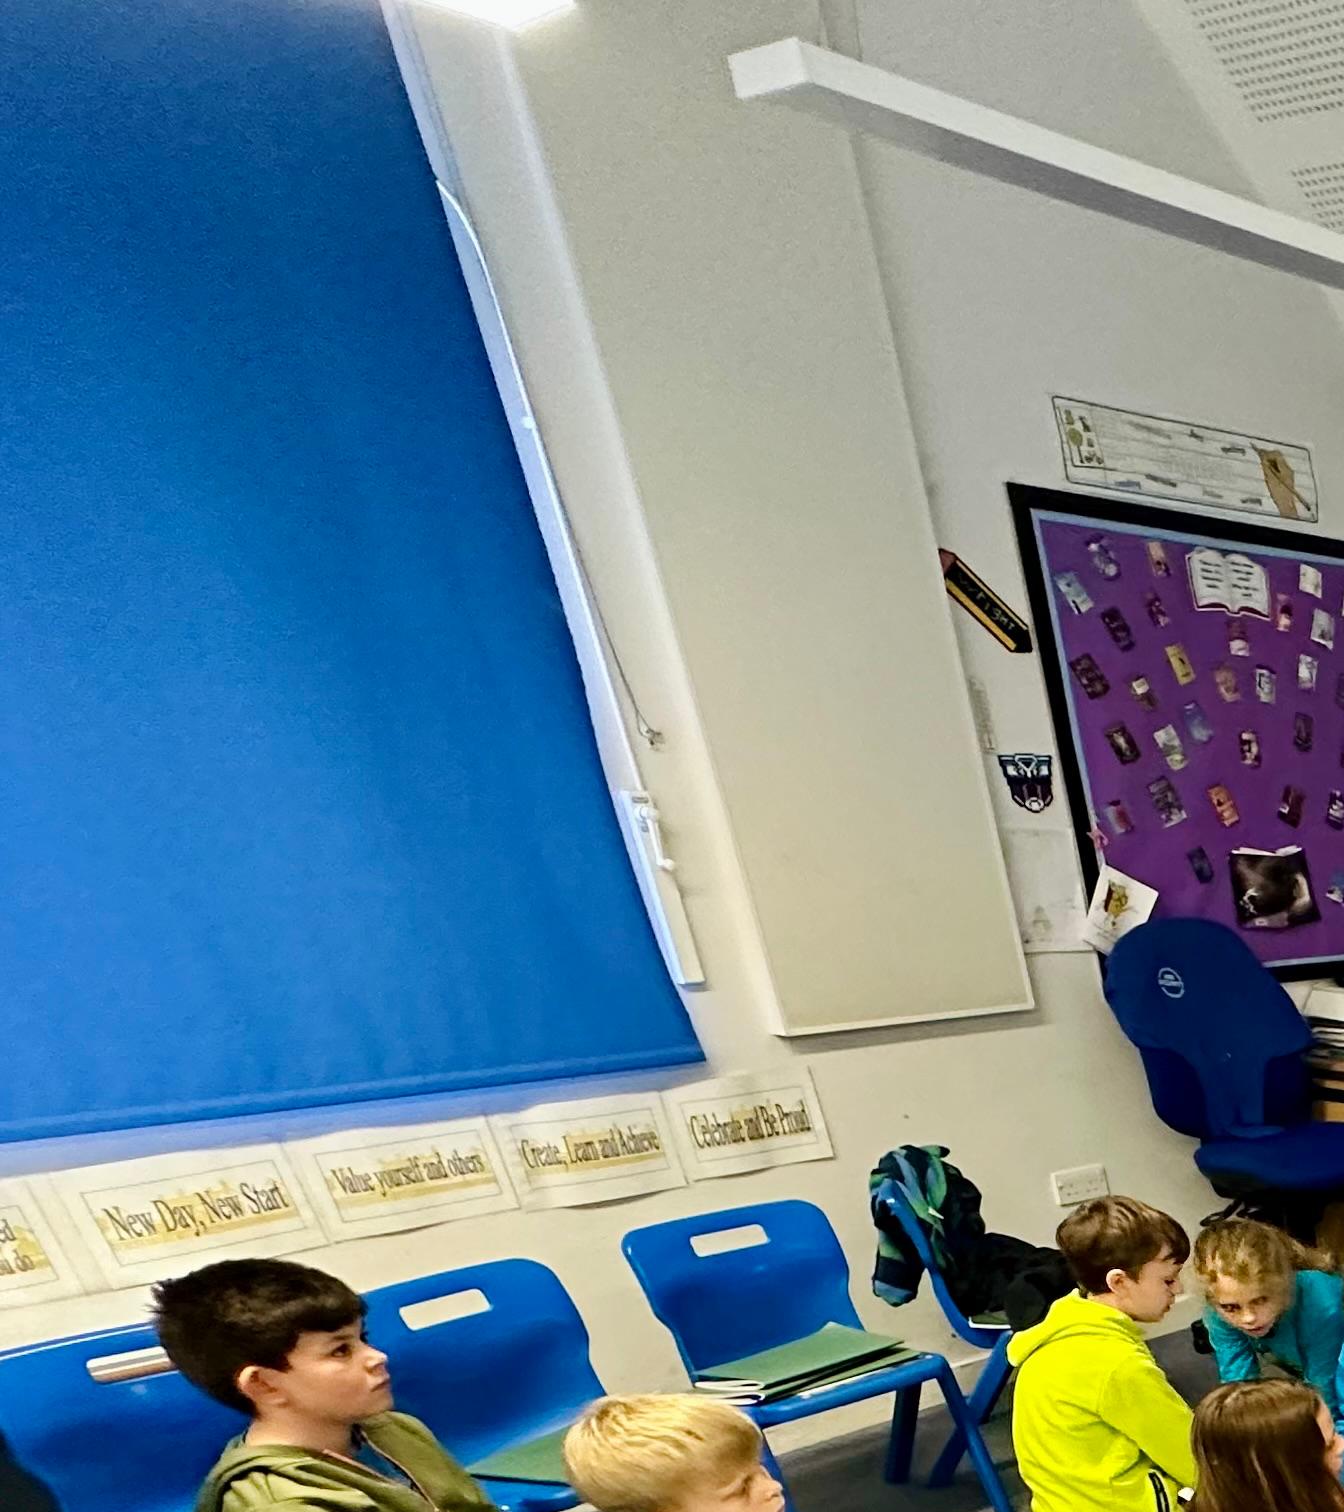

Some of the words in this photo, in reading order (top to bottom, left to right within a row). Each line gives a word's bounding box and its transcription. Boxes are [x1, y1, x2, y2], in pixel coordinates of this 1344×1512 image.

[519, 1136, 568, 1172] Create,
[562, 1131, 600, 1164] Learn
[600, 1127, 619, 1160] and
[619, 1121, 661, 1157] Achieve
[689, 1111, 743, 1150] Celebrate
[742, 1106, 763, 1144] and
[763, 1102, 780, 1139] Be
[777, 1098, 813, 1136] Proud
[329, 1166, 373, 1197] Value
[374, 1153, 422, 1199] yourself
[422, 1150, 448, 1182] and
[447, 1147, 486, 1177] others
[101, 1205, 156, 1243] New
[151, 1198, 208, 1238] Day,
[204, 1190, 247, 1225] New
[243, 1181, 291, 1215] Start
